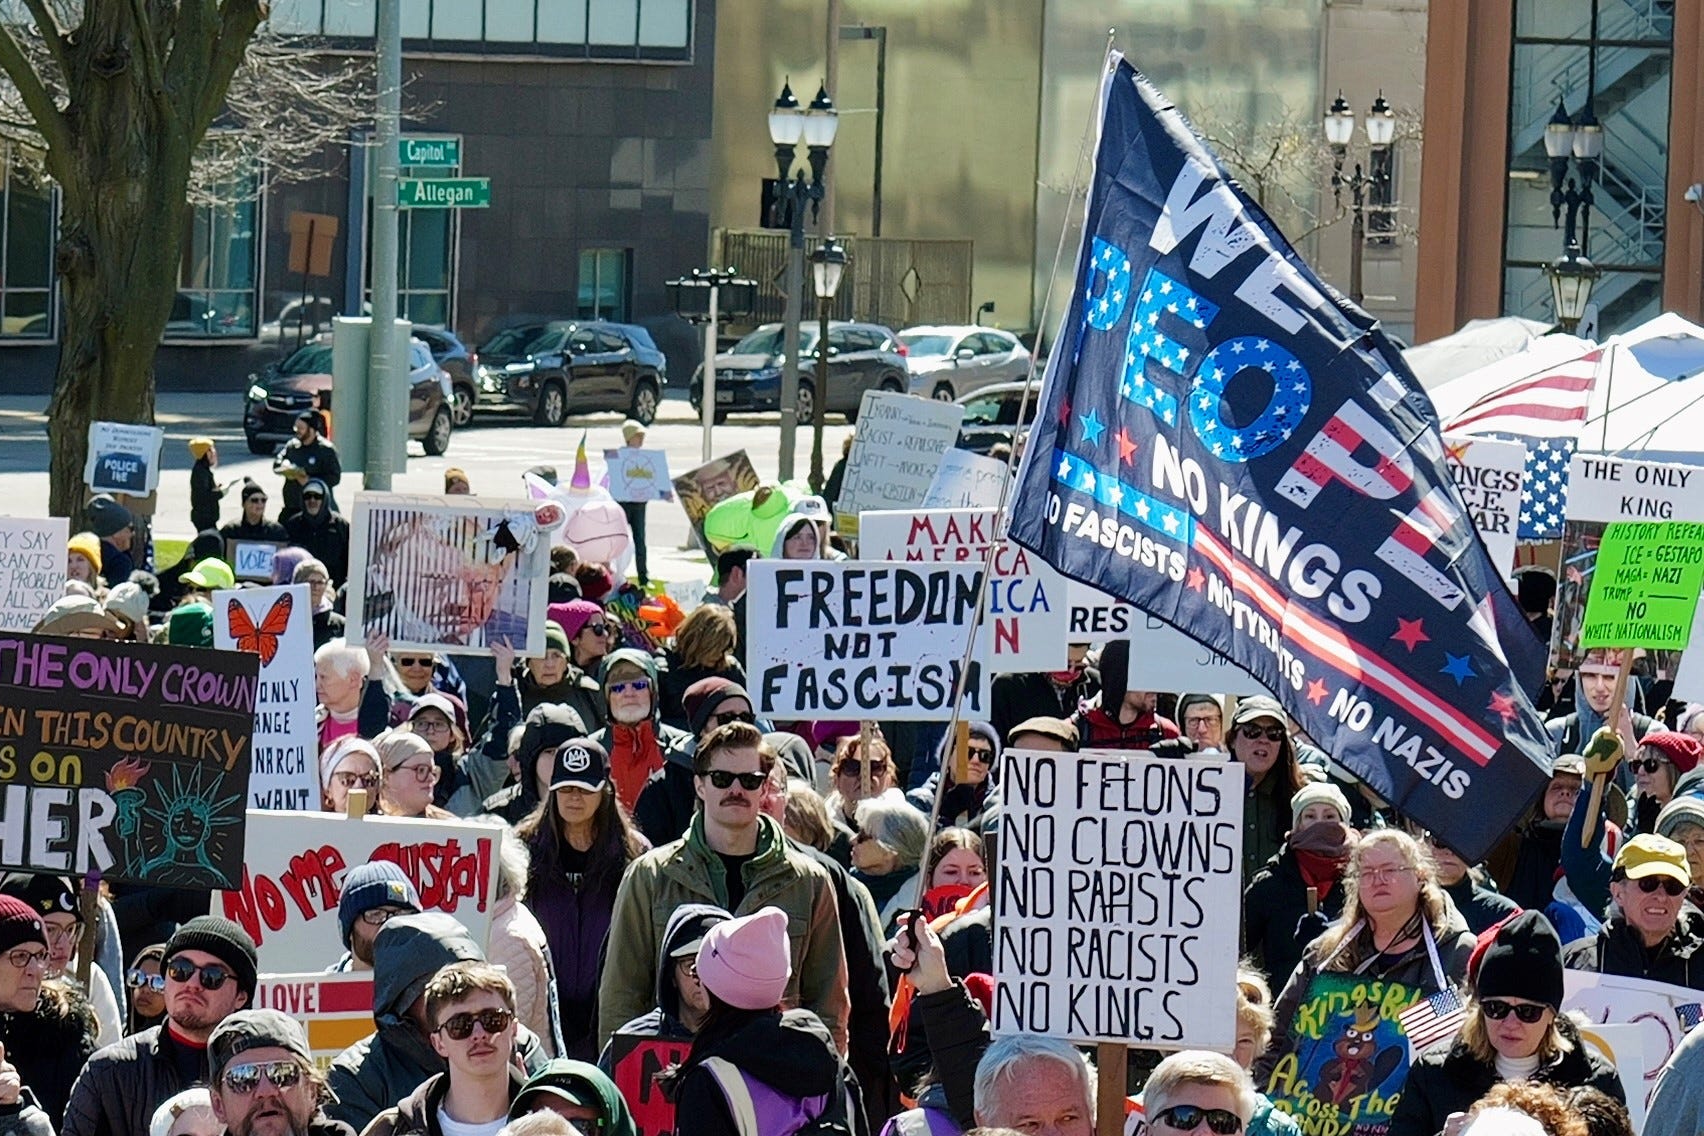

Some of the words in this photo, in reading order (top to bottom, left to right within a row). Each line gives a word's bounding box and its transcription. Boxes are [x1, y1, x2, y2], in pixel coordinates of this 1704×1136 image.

[407, 140, 445, 165] Capitol
[415, 180, 474, 206] Allegan
[104, 459, 138, 473] POLICE
[1583, 460, 1623, 482] THE
[1635, 465, 1692, 488] ONLY
[1620, 496, 1674, 519] KING
[22, 531, 53, 551] SAY
[1153, 433, 1207, 515] NO
[1219, 481, 1382, 623] KINGS
[1610, 524, 1661, 541] HISTORY
[1621, 545, 1644, 566] ICE
[1655, 545, 1703, 565] GESTAPO
[9, 571, 66, 591] PROBLEM
[1614, 568, 1643, 584] MAGA
[1652, 567, 1684, 585] NAZI
[3, 591, 29, 609] ALL
[775, 568, 985, 629] FREEDOM
[1603, 586, 1633, 601] TRUMP
[1625, 601, 1647, 621] NO
[823, 632, 897, 660] NOT
[1585, 624, 1613, 641] WHITE
[1616, 623, 1682, 642] NATIONALISM
[1063, 501, 1186, 582] FASCISTS
[1206, 572, 1234, 611] NO
[1328, 688, 1375, 733] NO
[1371, 717, 1471, 800] NAZIS
[68, 651, 159, 699] ONLY
[160, 663, 259, 713] CROWN
[259, 678, 300, 703] ONLY
[761, 660, 982, 713] FASCISM
[35, 708, 115, 750] THIS
[112, 714, 248, 772] COUNTRY
[1003, 755, 1056, 809] NO
[1076, 758, 1223, 817] FELONS
[1001, 813, 1055, 863] NO
[1071, 815, 1235, 874] CLOWNS
[280, 844, 348, 922] me
[999, 864, 1055, 920] NO
[1067, 869, 1205, 928] RAPISTS
[998, 925, 1052, 977] NO
[1067, 926, 1199, 986] RACISTS
[260, 982, 319, 1015] LOVE
[996, 981, 1050, 1033] NO
[1067, 983, 1184, 1041] KINGS
[1296, 981, 1384, 1040] Kings
[1266, 1053, 1341, 1120] Across
[1349, 1089, 1401, 1121] The
